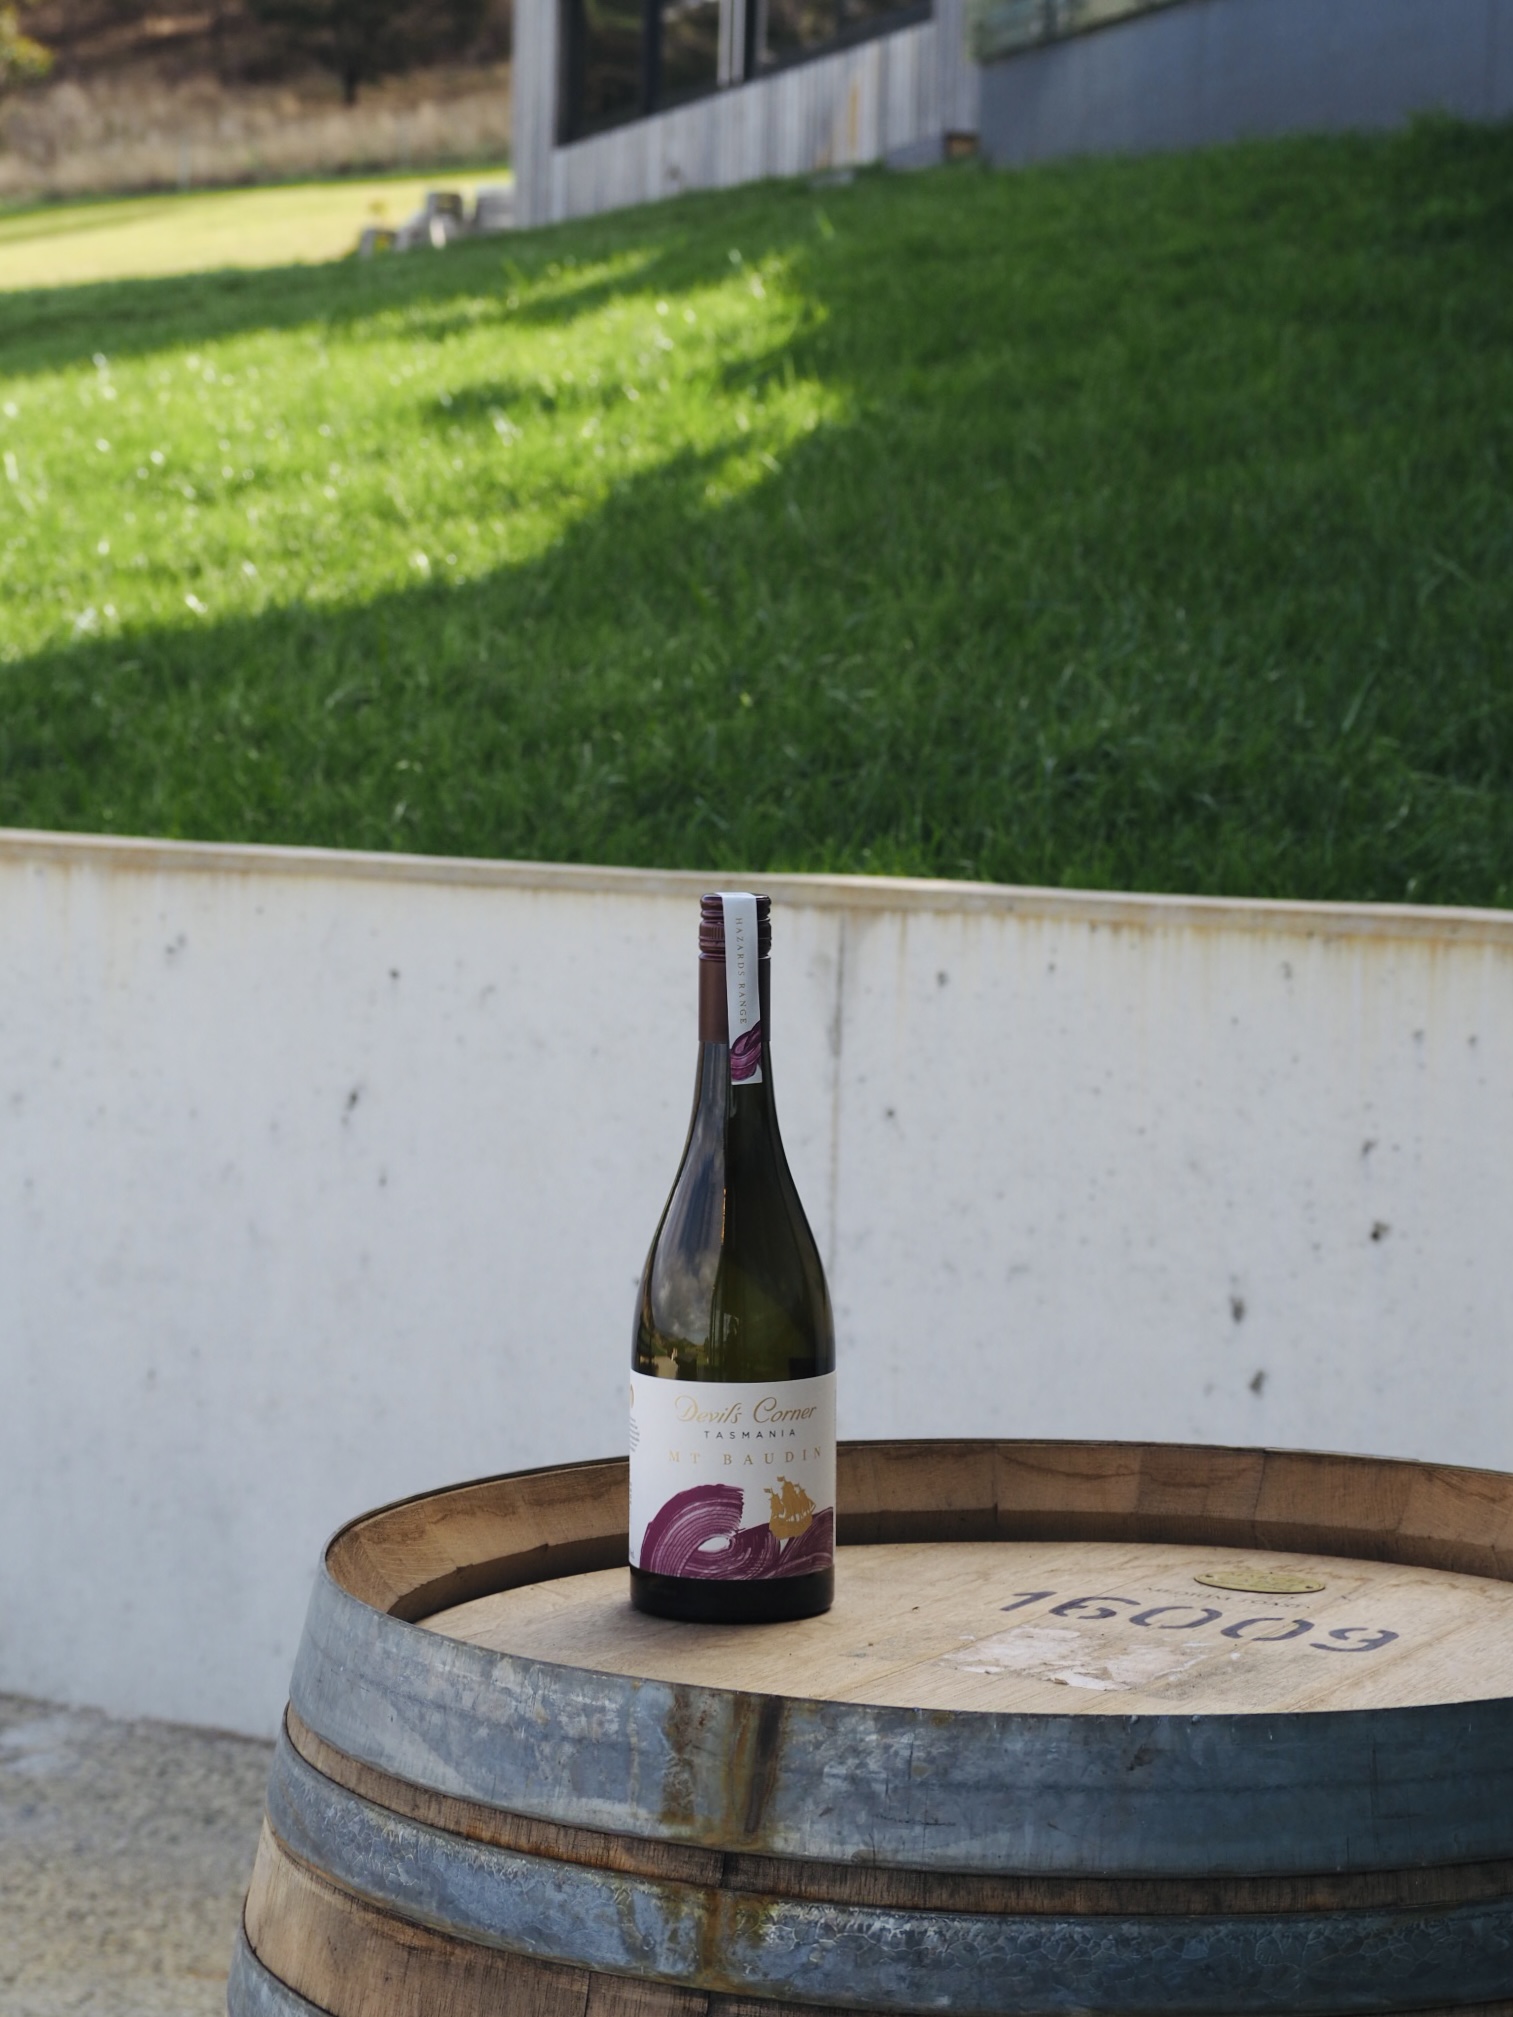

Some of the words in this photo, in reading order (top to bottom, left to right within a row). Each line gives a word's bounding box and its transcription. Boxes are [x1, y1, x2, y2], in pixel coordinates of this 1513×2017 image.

[735, 917, 745, 977] HAZARDS
[738, 983, 747, 1024] RANGE
[674, 1395, 742, 1424] Devil's
[753, 1397, 817, 1424] Corner
[704, 1429, 796, 1440] TASMANIA
[668, 1450, 700, 1464] MT
[723, 1446, 822, 1465] BAUDIN
[1000, 1591, 1400, 1653] 16009
